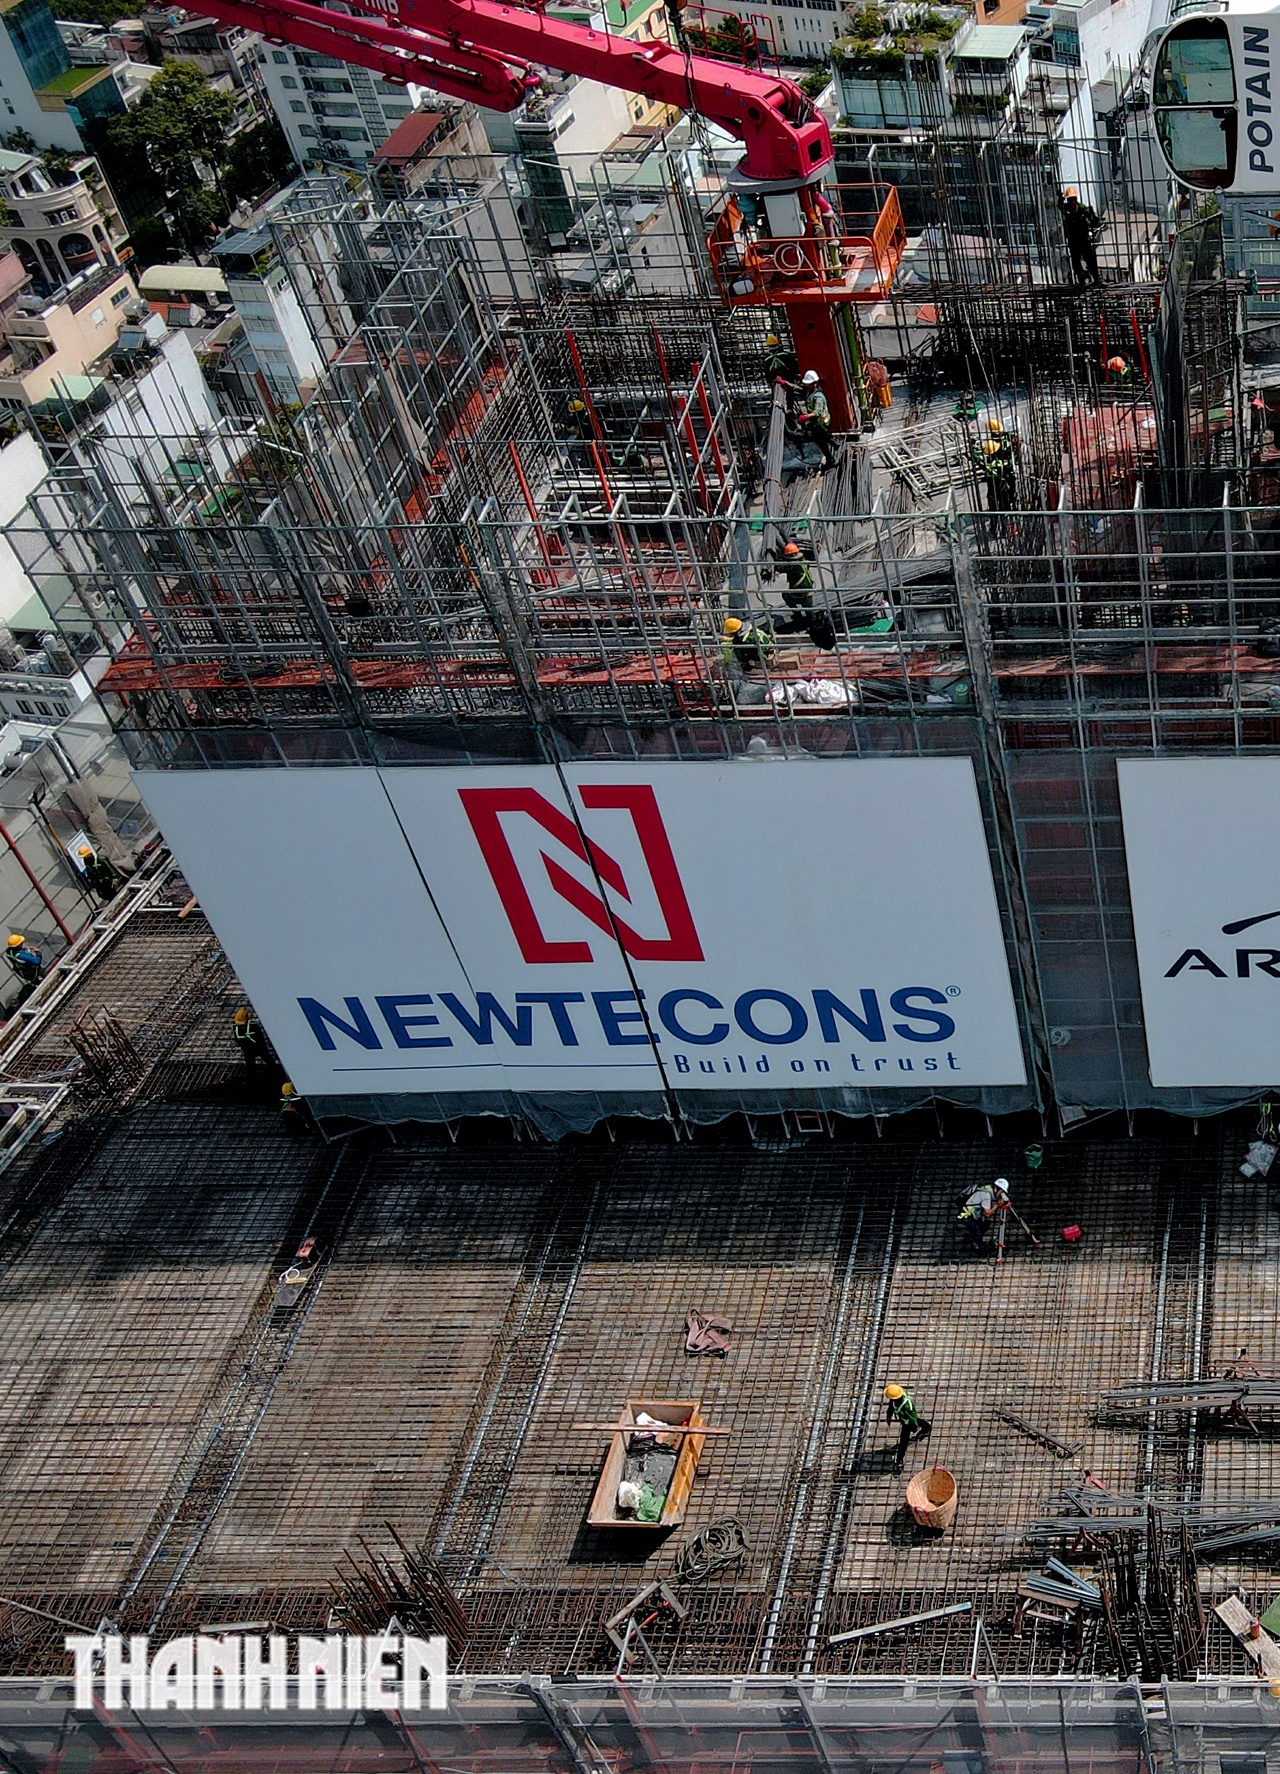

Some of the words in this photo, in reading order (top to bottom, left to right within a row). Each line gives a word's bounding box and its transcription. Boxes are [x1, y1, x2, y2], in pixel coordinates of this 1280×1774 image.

[1242, 26, 1275, 173] POTAIN
[673, 1054, 771, 1074] Build
[790, 1058, 831, 1073] on
[850, 1051, 962, 1072] trust
